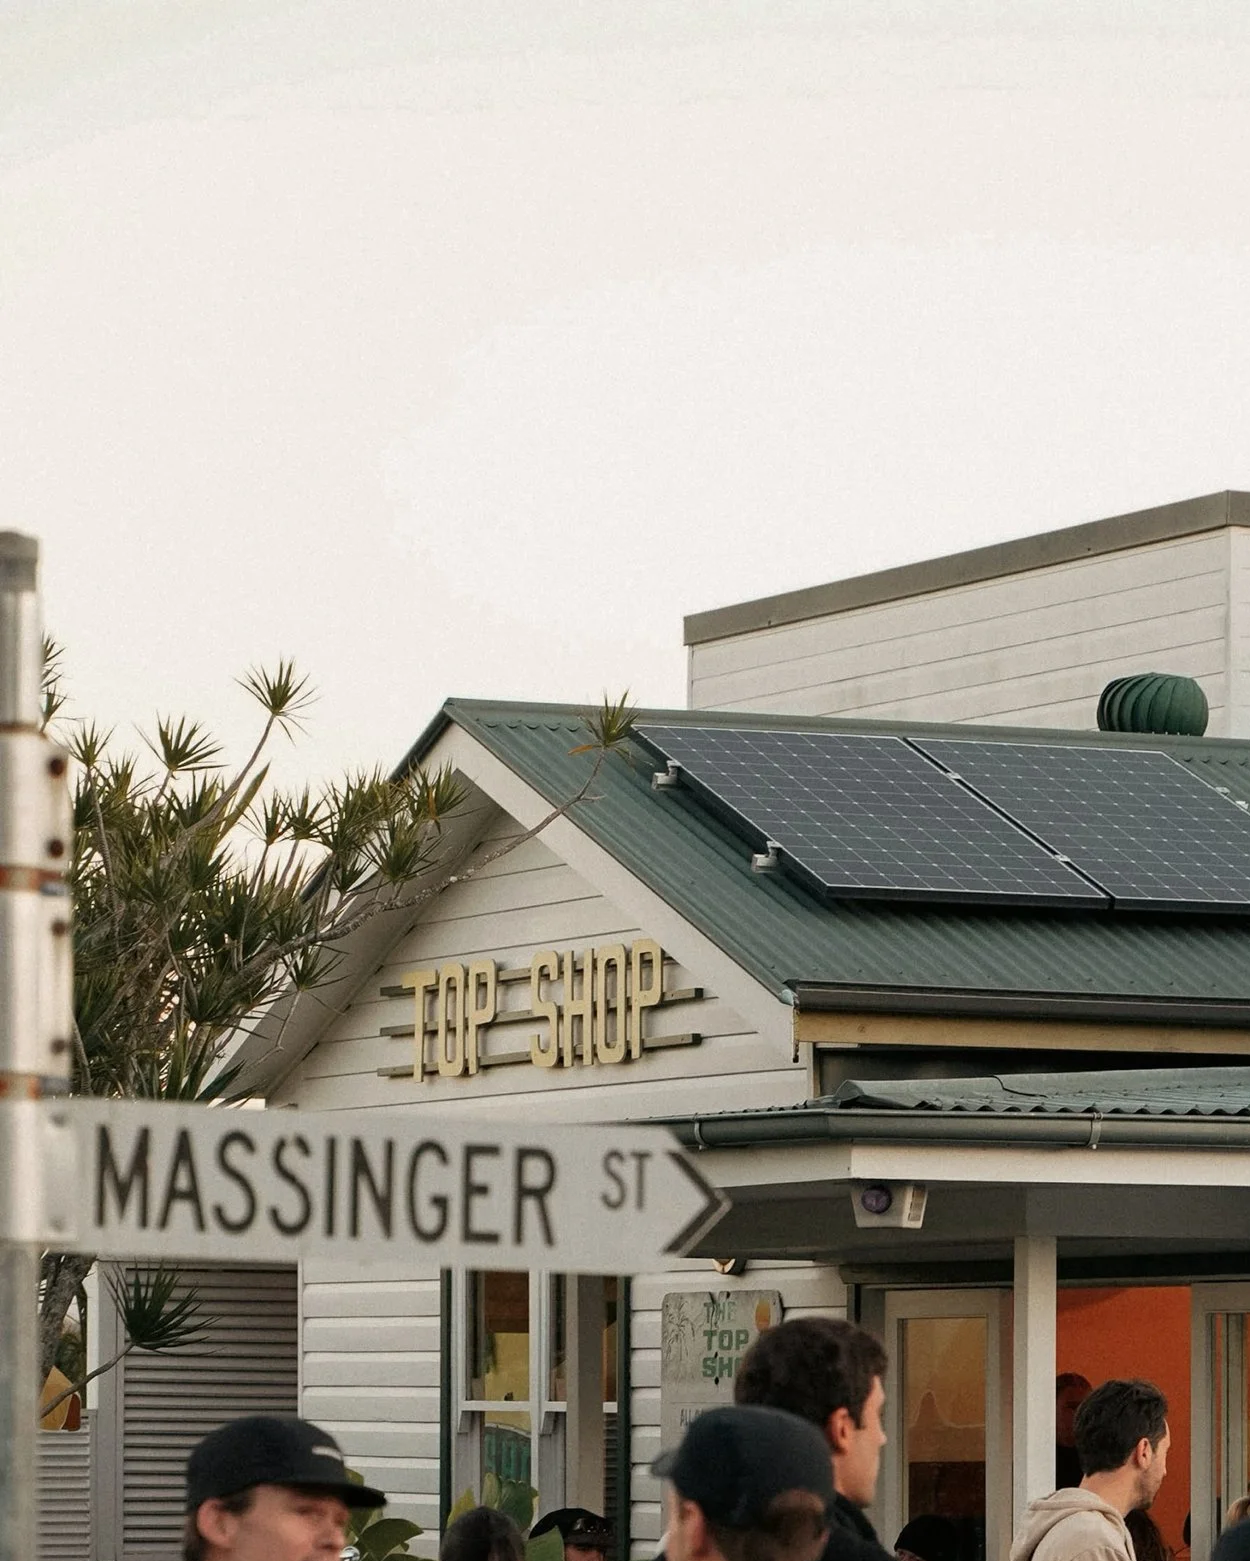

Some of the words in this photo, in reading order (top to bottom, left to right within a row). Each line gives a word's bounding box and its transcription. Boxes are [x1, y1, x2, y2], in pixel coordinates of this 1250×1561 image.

[402, 959, 497, 1082] TOP
[529, 939, 664, 1067] SHOP
[93, 1124, 557, 1247] MASSINGER
[601, 1149, 653, 1211] ST
[702, 1356, 743, 1378] SH
[703, 1329, 749, 1351] TOP
